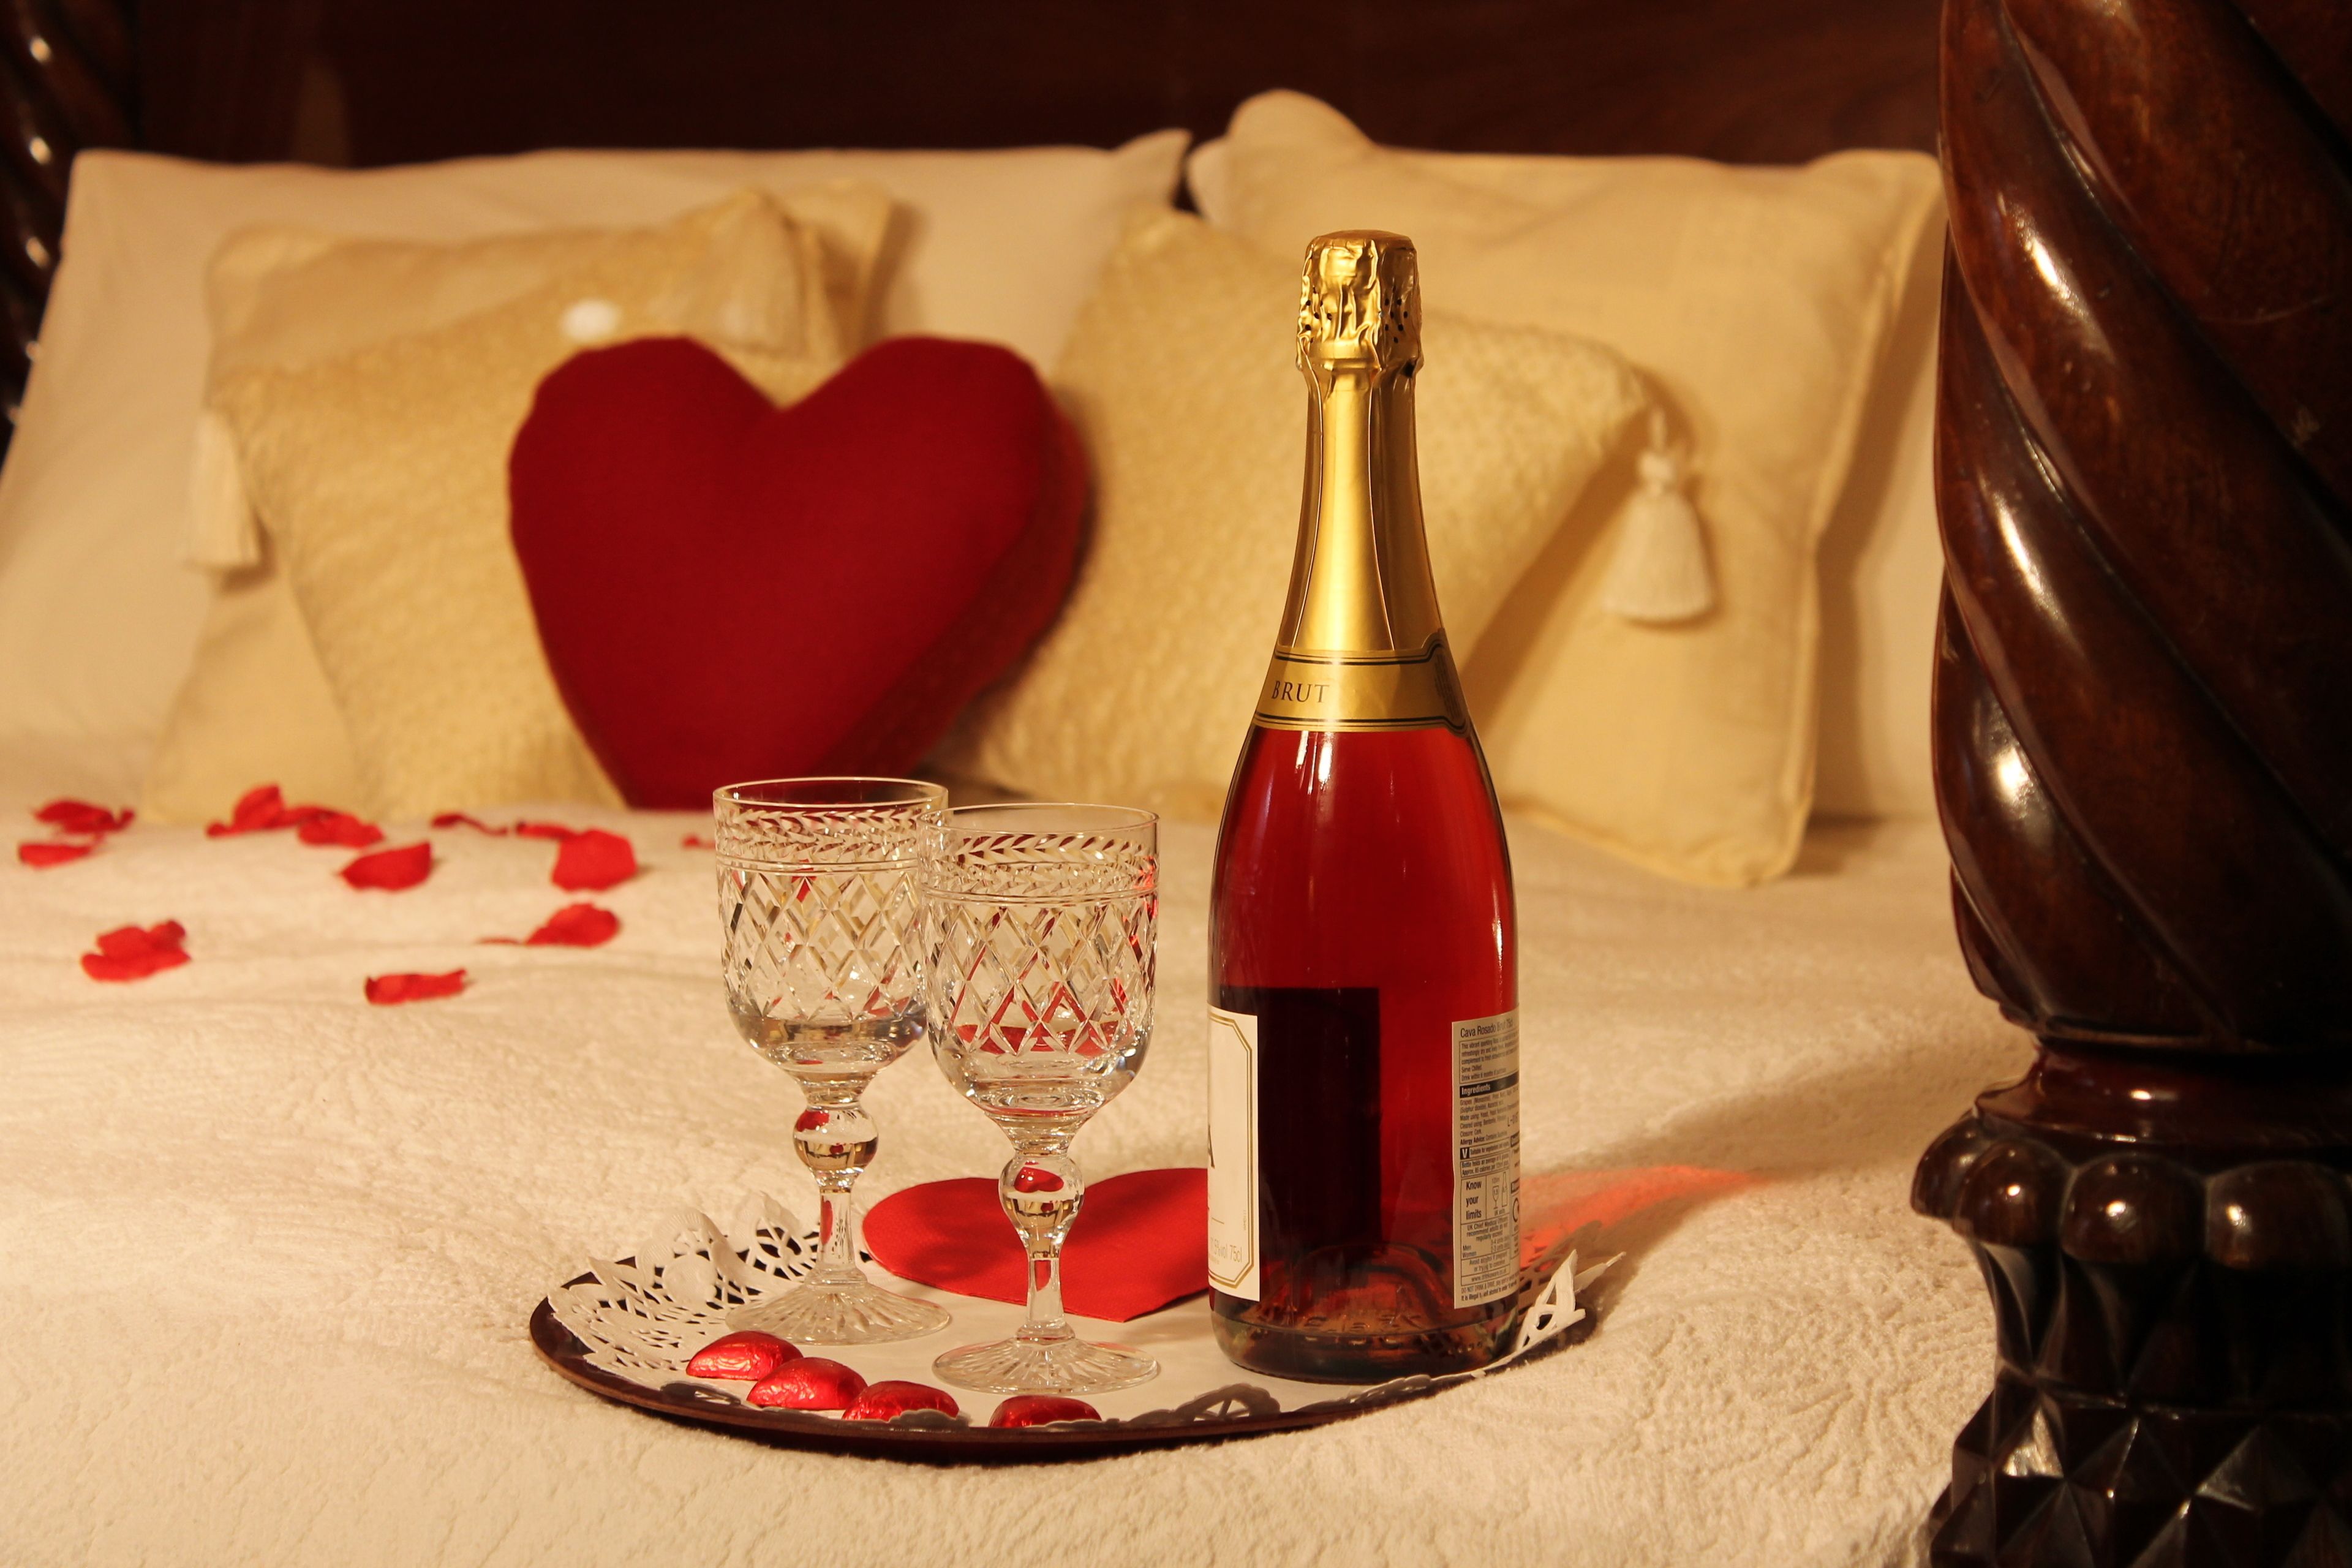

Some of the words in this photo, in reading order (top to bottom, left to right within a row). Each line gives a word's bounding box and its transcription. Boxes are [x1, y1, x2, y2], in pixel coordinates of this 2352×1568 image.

[1271, 680, 1330, 703] BRUT
[1461, 1028, 1476, 1038] Cava
[1477, 1023, 1496, 1035] Rosado
[1461, 1084, 1490, 1096] Ingredients
[1462, 1148, 1468, 1159] V
[1466, 1181, 1482, 1190] Know
[1466, 1196, 1479, 1207] your
[1466, 1209, 1482, 1220] limits
[1467, 1227, 1489, 1237] recommend
[1230, 1243, 1242, 1262] 75cl
